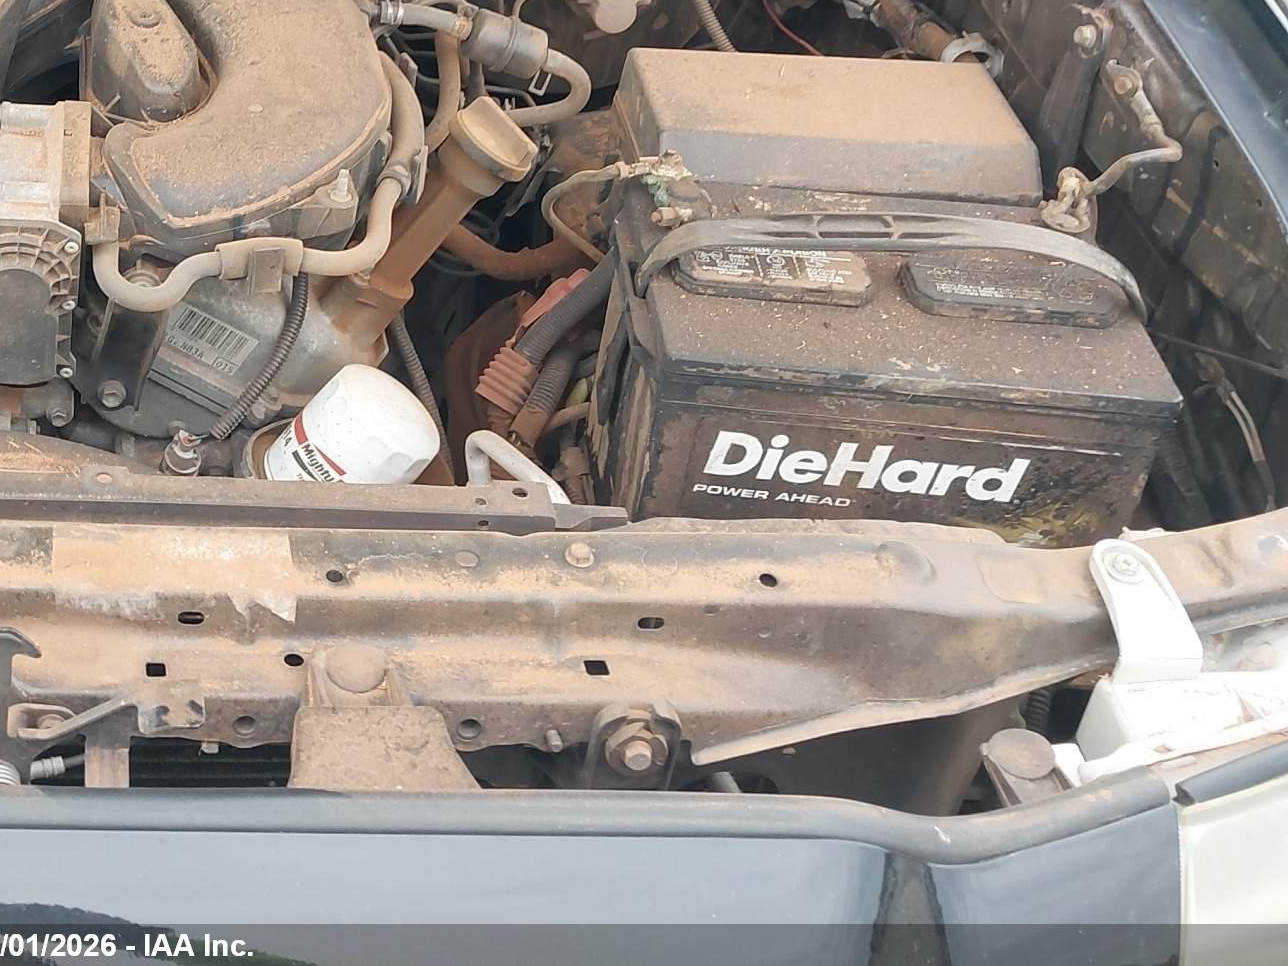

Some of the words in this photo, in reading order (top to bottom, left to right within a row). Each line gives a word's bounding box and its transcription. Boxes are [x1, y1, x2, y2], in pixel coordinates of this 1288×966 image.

[703, 430, 1031, 503] DieHard
[692, 483, 770, 501] POWER
[774, 492, 850, 507] AHEAD
